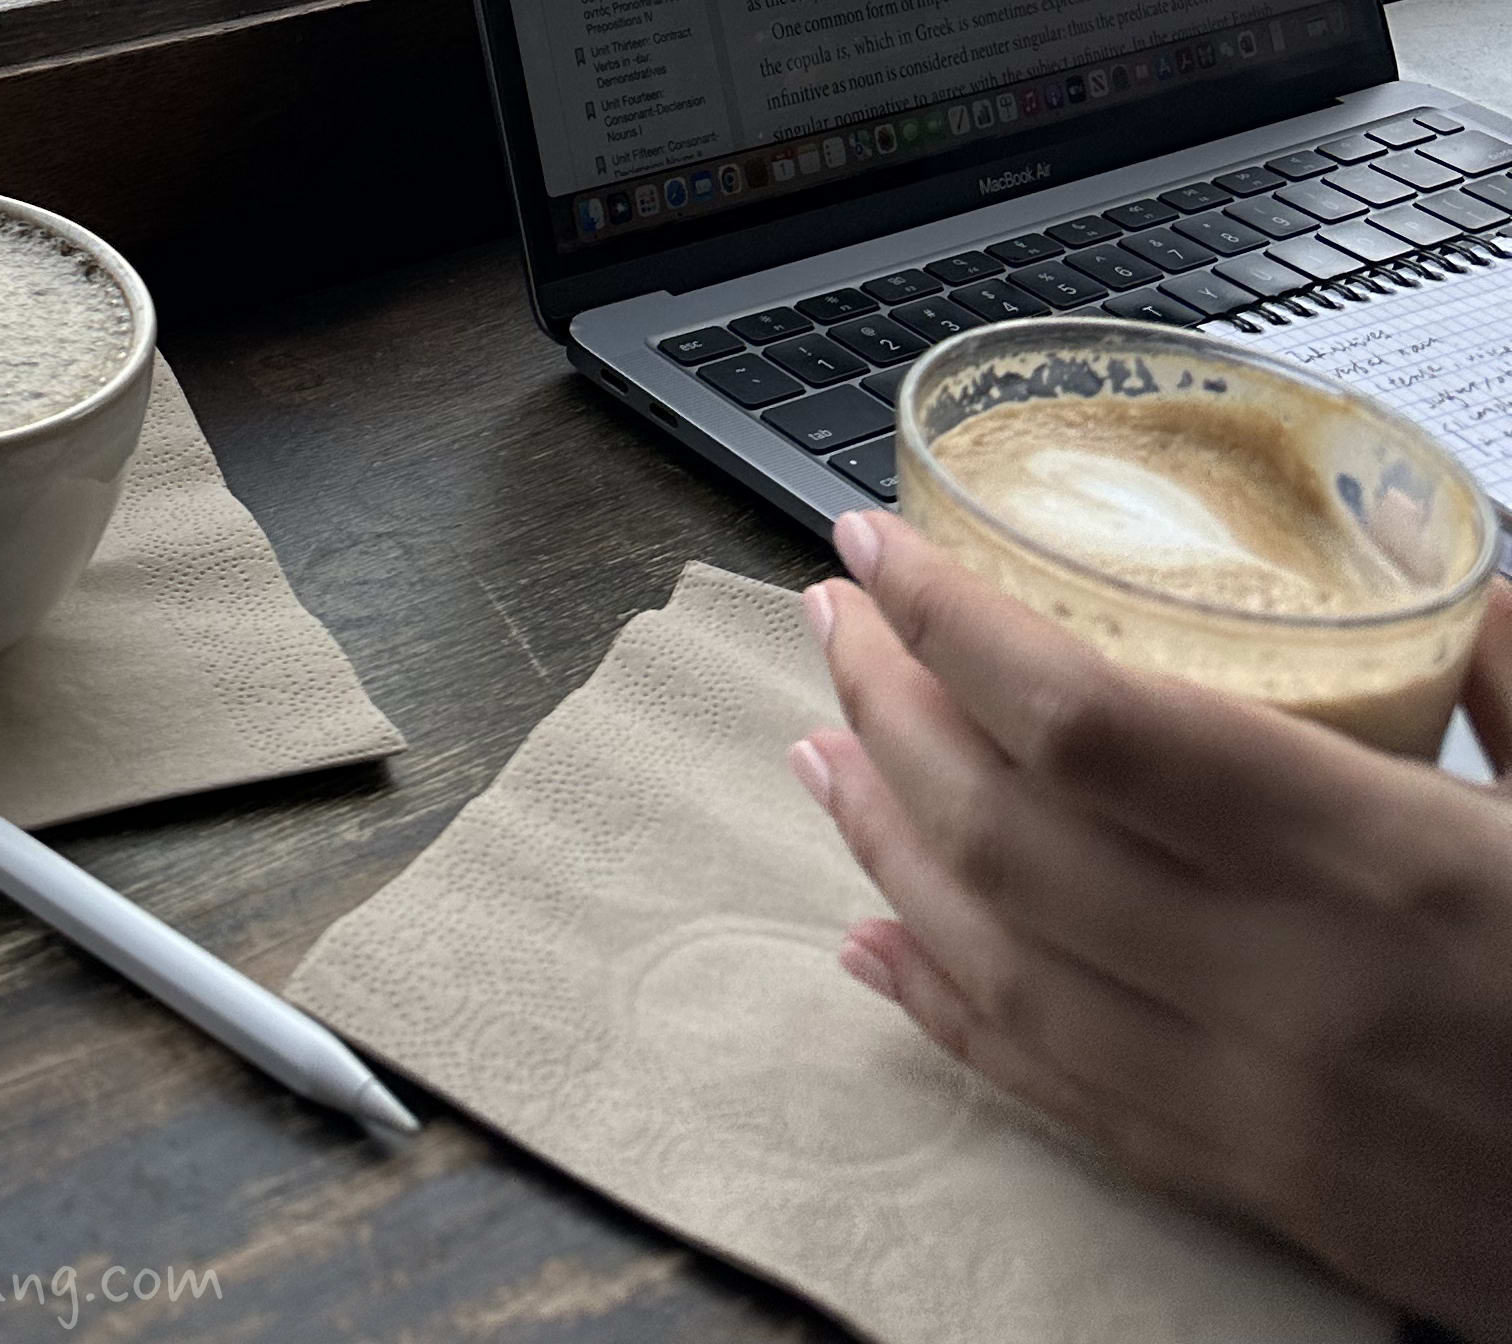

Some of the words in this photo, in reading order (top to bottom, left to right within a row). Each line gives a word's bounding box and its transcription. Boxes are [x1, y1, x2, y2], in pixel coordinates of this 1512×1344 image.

[770, 21, 802, 40] One
[803, 10, 864, 33] common
[864, 2, 898, 20] form
[758, 57, 783, 77] the
[785, 46, 832, 73] copula
[834, 43, 851, 61] is,
[854, 30, 895, 55] which
[896, 29, 913, 45] in
[913, 16, 954, 41] Greek
[956, 15, 969, 31] is
[971, 2, 1039, 28] sometimes
[765, 83, 831, 110] infinitive
[830, 80, 847, 94] as
[848, 72, 884, 90] noun
[884, 65, 898, 82] is
[898, 45, 968, 79] considered
[969, 40, 1010, 61] neuter
[1066, 18, 1095, 37] thus
[1094, 11, 1115, 30] the
[1116, 0, 1170, 30] predicate
[978, 165, 1036, 196] MacBook
[1035, 160, 1052, 179] Air
[1220, 232, 1239, 243] 8
[1167, 248, 1184, 260] 7
[1113, 266, 1133, 278] 6
[1057, 283, 1077, 295] 5
[1001, 300, 1019, 312] 4
[879, 338, 901, 351] 2
[807, 428, 833, 441] tab
